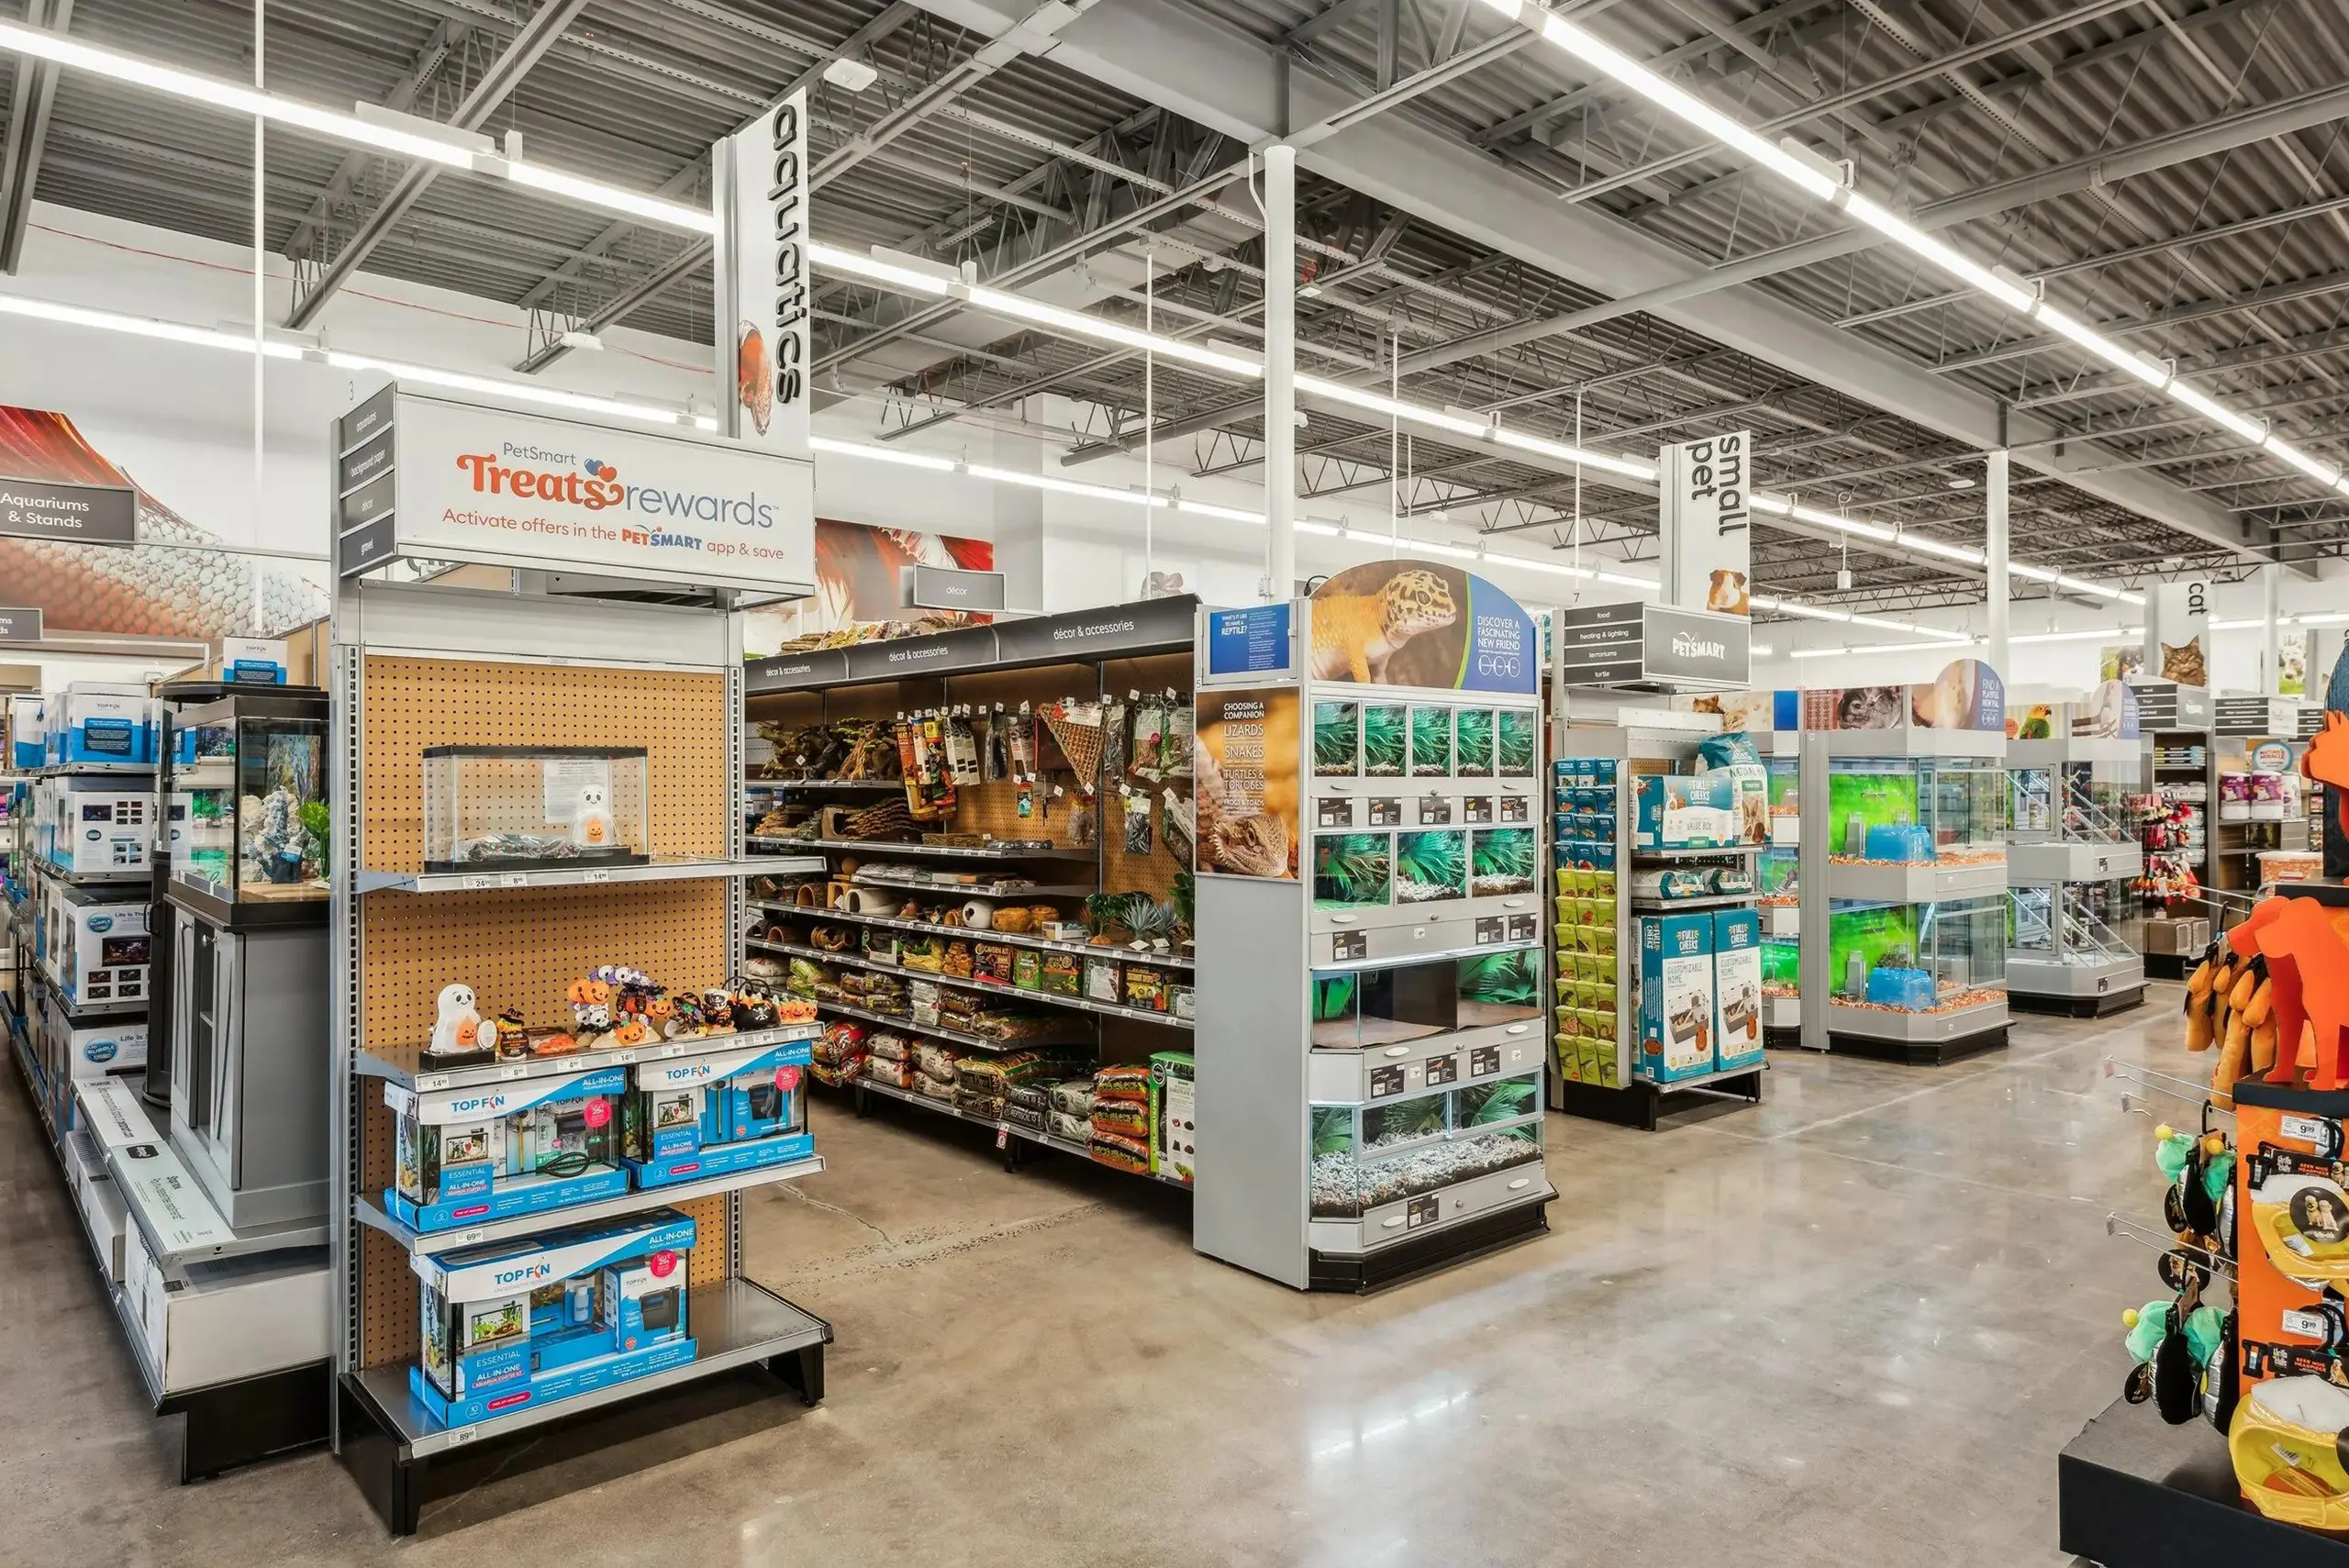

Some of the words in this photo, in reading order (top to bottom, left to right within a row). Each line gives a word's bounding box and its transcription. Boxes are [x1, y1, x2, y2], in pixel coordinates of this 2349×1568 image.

[767, 104, 807, 405] aquatics
[349, 381, 354, 401] 3
[356, 412, 377, 432] aquariums
[503, 442, 576, 466] PetSmart
[351, 456, 373, 478] background
[373, 449, 385, 467] paper
[1686, 441, 1717, 500] pet
[456, 452, 625, 510] Treats
[1719, 435, 1747, 537] small
[1, 493, 90, 512] Aquariums
[8, 510, 22, 522] &
[26, 512, 83, 528] Stands
[441, 507, 518, 531] Activate
[521, 517, 570, 537] offers
[573, 524, 587, 539] in
[591, 525, 617, 541] the
[621, 526, 703, 550] PETSMART
[707, 539, 735, 557] app
[739, 541, 750, 556] &
[753, 547, 785, 561] save
[946, 585, 968, 596] décor
[1573, 592, 1580, 603] 7
[2188, 583, 2208, 616] cat
[1597, 610, 1610, 619] food
[1477, 616, 1513, 628] DISCOVER
[1514, 619, 1520, 629] A
[1053, 626, 1076, 640] décor
[1078, 625, 1085, 637] &
[1085, 620, 1134, 636] accessories
[1221, 626, 1248, 636] REPTILE?
[1477, 627, 1520, 639] FASCINATING
[1579, 631, 1601, 640] heating
[1608, 628, 1629, 639] lighting
[1477, 638, 1495, 648] NEW
[1496, 639, 1520, 650] FRIEND
[1672, 635, 1726, 660] PETSMART
[888, 651, 906, 662] décor
[907, 651, 911, 660] &
[912, 646, 949, 660] accessories
[765, 666, 779, 677] décor
[784, 664, 811, 675] accessories
[1223, 702, 1258, 711] CHOOSING
[1259, 702, 1264, 710] A
[1223, 711, 1264, 720] COMPANION
[1223, 724, 1264, 737] LIZARDS
[1225, 745, 1264, 758] SNAKES
[1223, 769, 1257, 780] TURTLES
[1224, 780, 1264, 790] TORTOISES
[1692, 780, 1706, 790] FULL
[1690, 790, 1709, 801] CHEEKS
[1682, 930, 1695, 940] FULL
[1732, 925, 1744, 934] FULL
[1731, 933, 1748, 944] CHEEKS
[1678, 940, 1698, 951] CHEEKS
[774, 1046, 810, 1058] ALL-IN-ONE
[582, 1073, 625, 1086] ALL-IN-ONE
[451, 1098, 480, 1112] TOP
[661, 1130, 693, 1140] ESSENTIAL
[661, 1140, 693, 1151] ALL-IN-ONE
[448, 1168, 486, 1179] ESSENTIAL
[2299, 1167, 2329, 1176] HEADPIECE
[448, 1179, 486, 1191] ALL-IN-ONE
[649, 1228, 695, 1244] ALL-IN-ONE
[494, 1270, 524, 1284] TOP
[476, 1351, 521, 1368] ESSENTIAL
[476, 1363, 521, 1382] ALL-IN-ONE
[2295, 1362, 2327, 1373] HEADPIECE
